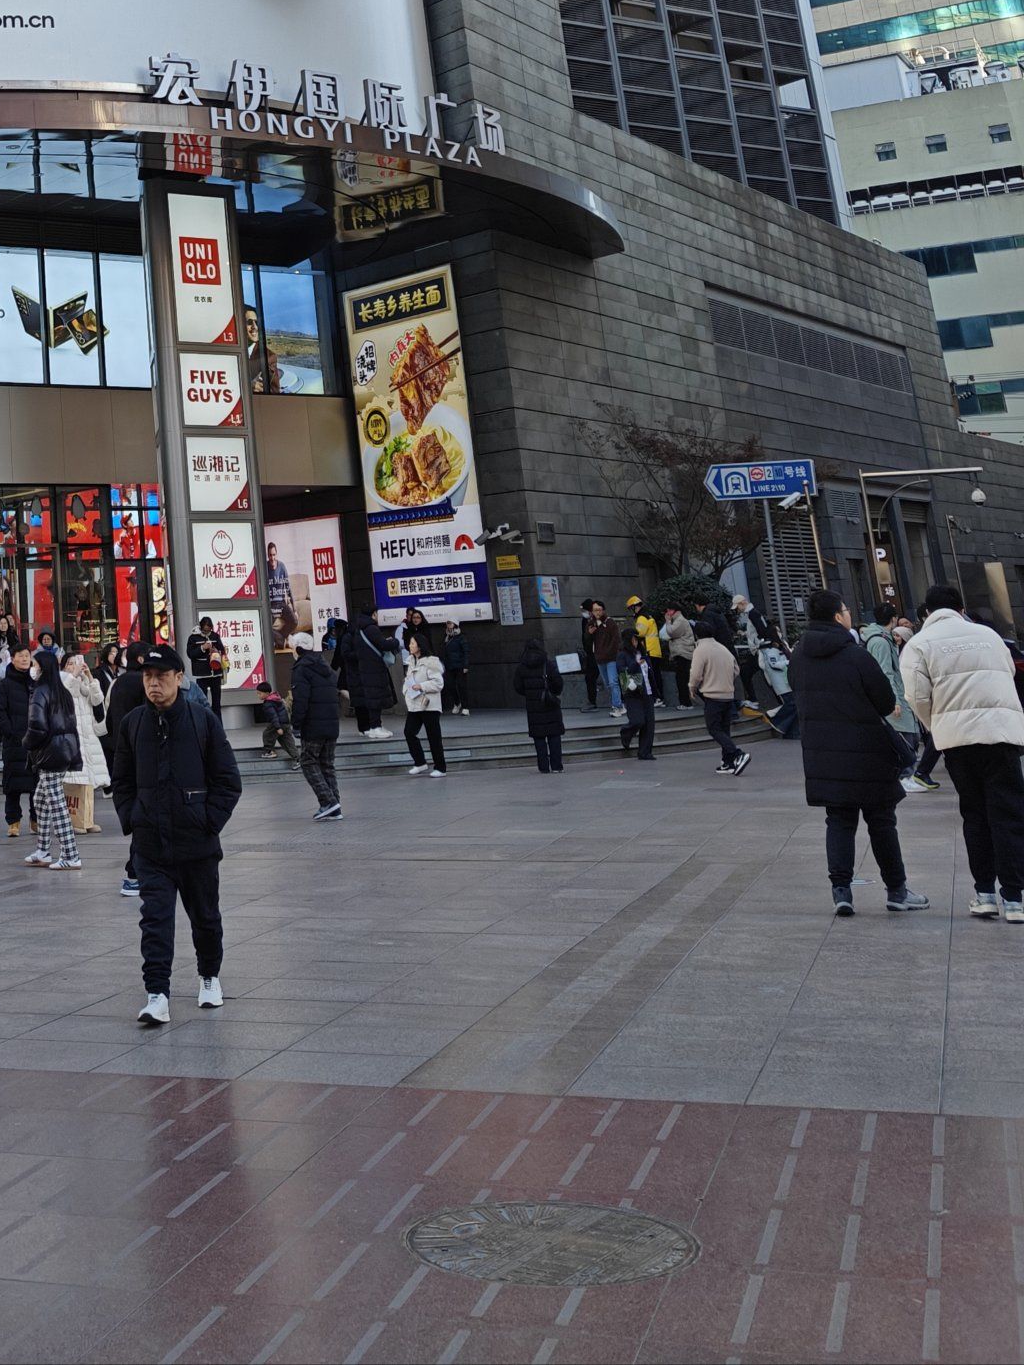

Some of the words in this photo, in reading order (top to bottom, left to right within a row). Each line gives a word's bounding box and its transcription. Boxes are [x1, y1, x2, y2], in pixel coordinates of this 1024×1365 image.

[148, 52, 506, 155] 宏伊国际广场
[209, 107, 352, 144] HONGYI
[382, 128, 482, 168] PLAZA
[183, 242, 212, 261] UNI
[185, 262, 216, 282] QLO
[358, 284, 441, 322] 长寿乡养生面
[223, 333, 233, 341] L3
[364, 345, 376, 373] 招牌
[190, 370, 227, 384] FIVE
[187, 388, 233, 403] GUYS
[231, 415, 241, 424] L1
[192, 455, 240, 472] 巡湘记
[784, 466, 807, 478] 号线
[753, 484, 770, 492] LINE
[237, 498, 249, 509] L6
[380, 538, 416, 560] HEFU
[876, 548, 887, 562] P
[315, 552, 331, 565] UNI
[202, 563, 247, 579] 小杨生煎
[317, 567, 334, 583] QLO
[244, 584, 255, 595] B1
[400, 575, 473, 594] 用餐请至宏伊B1层
[318, 607, 340, 619] 优衣库
[216, 620, 255, 637] 杨生煎
[252, 674, 263, 684] B1
[66, 795, 79, 809] UJI
